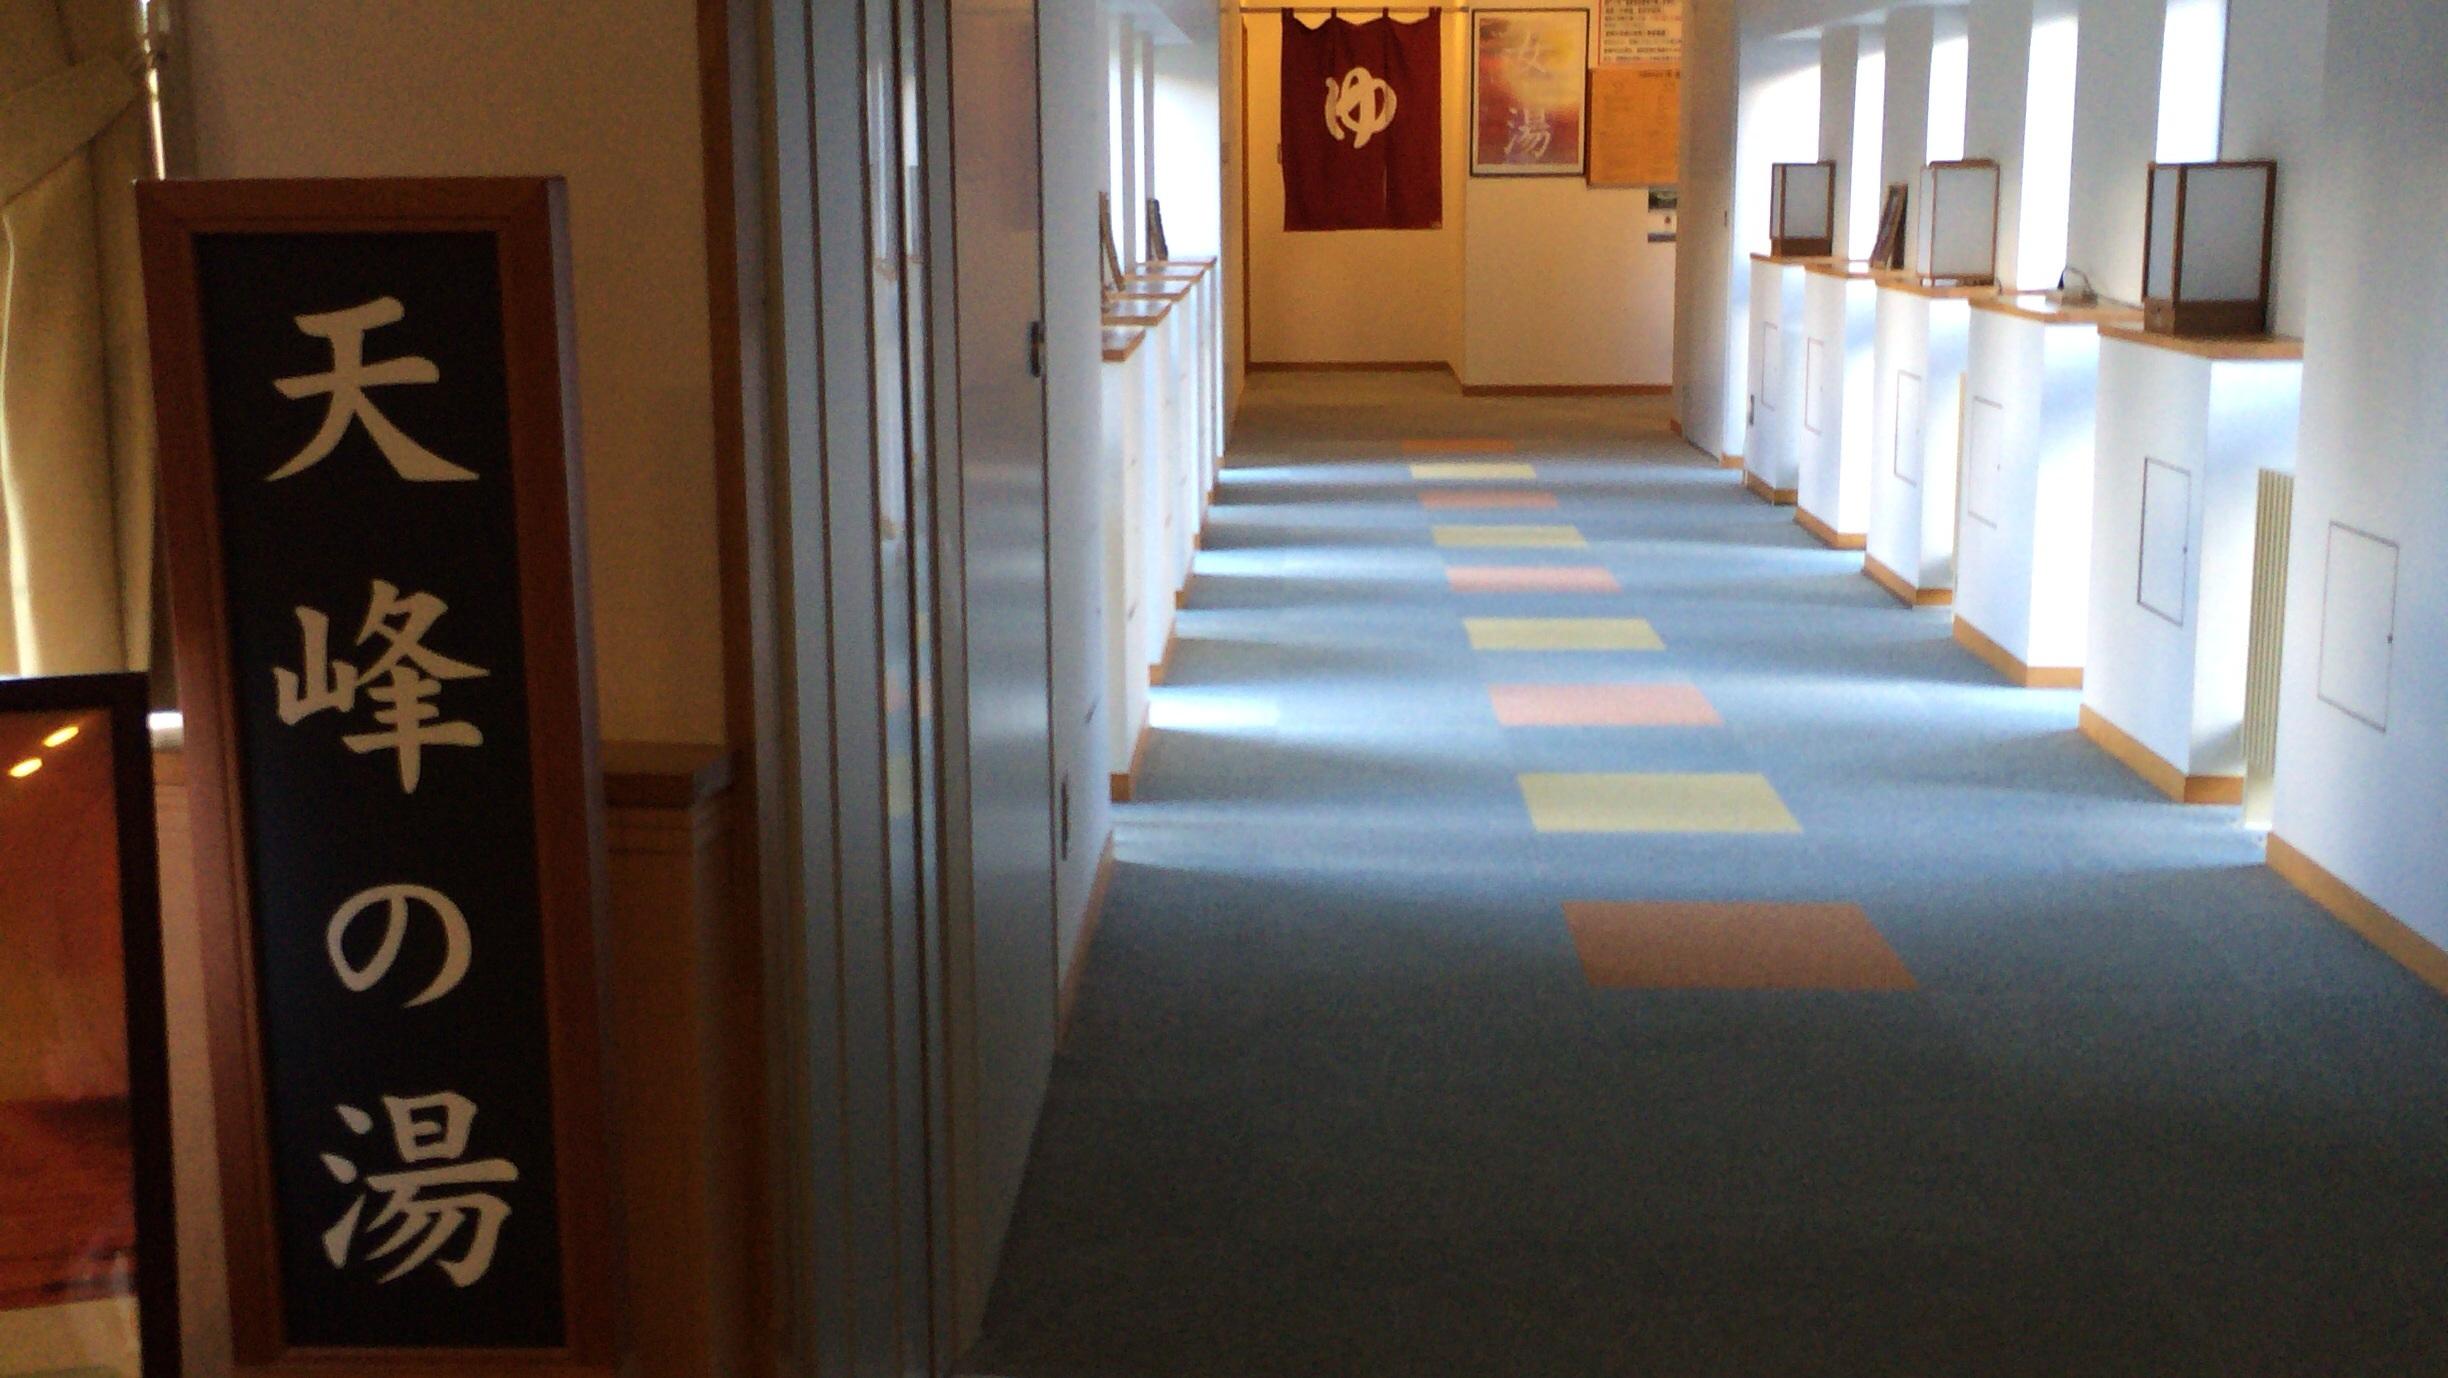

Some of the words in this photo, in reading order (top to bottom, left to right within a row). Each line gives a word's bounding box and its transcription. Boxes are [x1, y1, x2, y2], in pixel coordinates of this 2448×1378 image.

[1325, 67, 1397, 149] ゆ
[264, 295, 520, 1288] 天峰の湯
